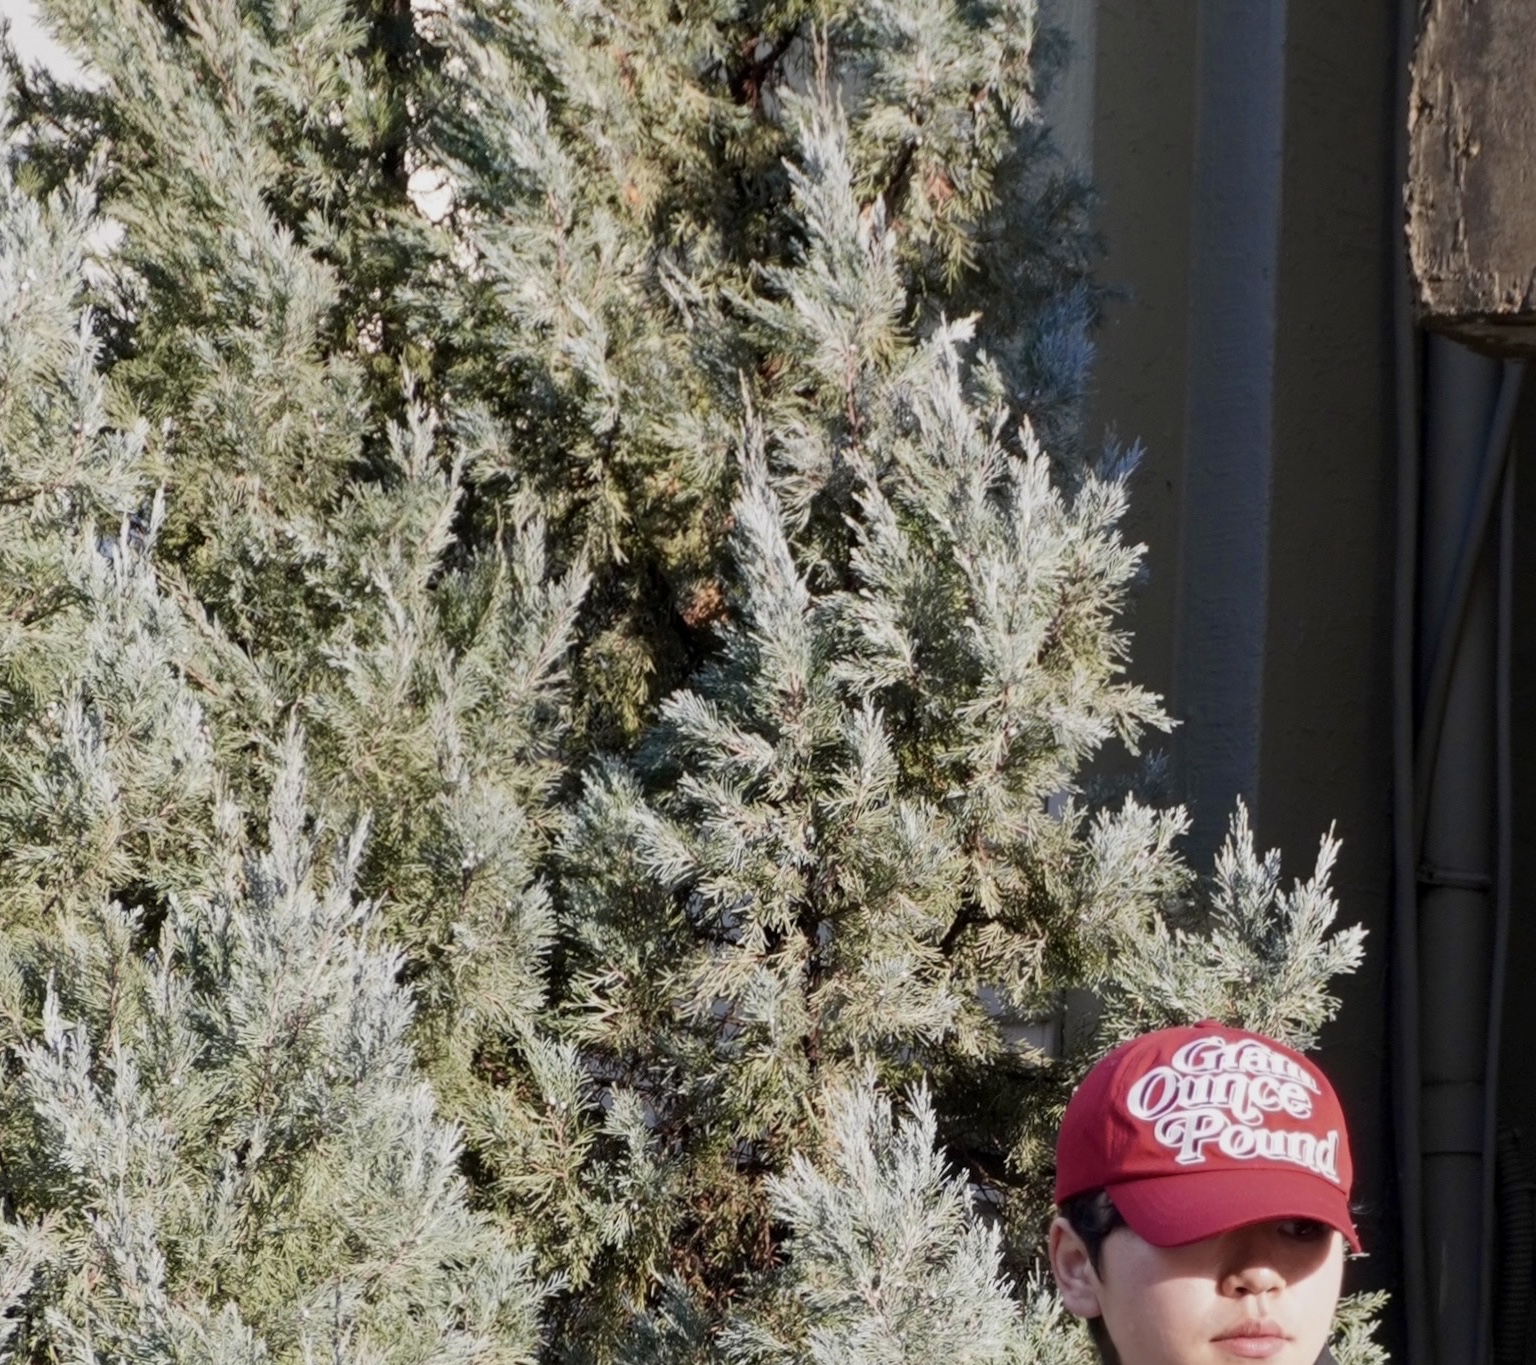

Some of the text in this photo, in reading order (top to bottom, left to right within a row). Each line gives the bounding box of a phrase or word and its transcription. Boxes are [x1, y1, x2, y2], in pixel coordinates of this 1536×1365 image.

[1171, 1036, 1322, 1095] Gram
[1127, 1066, 1313, 1126] Ounce
[1154, 1108, 1341, 1184] Pound
